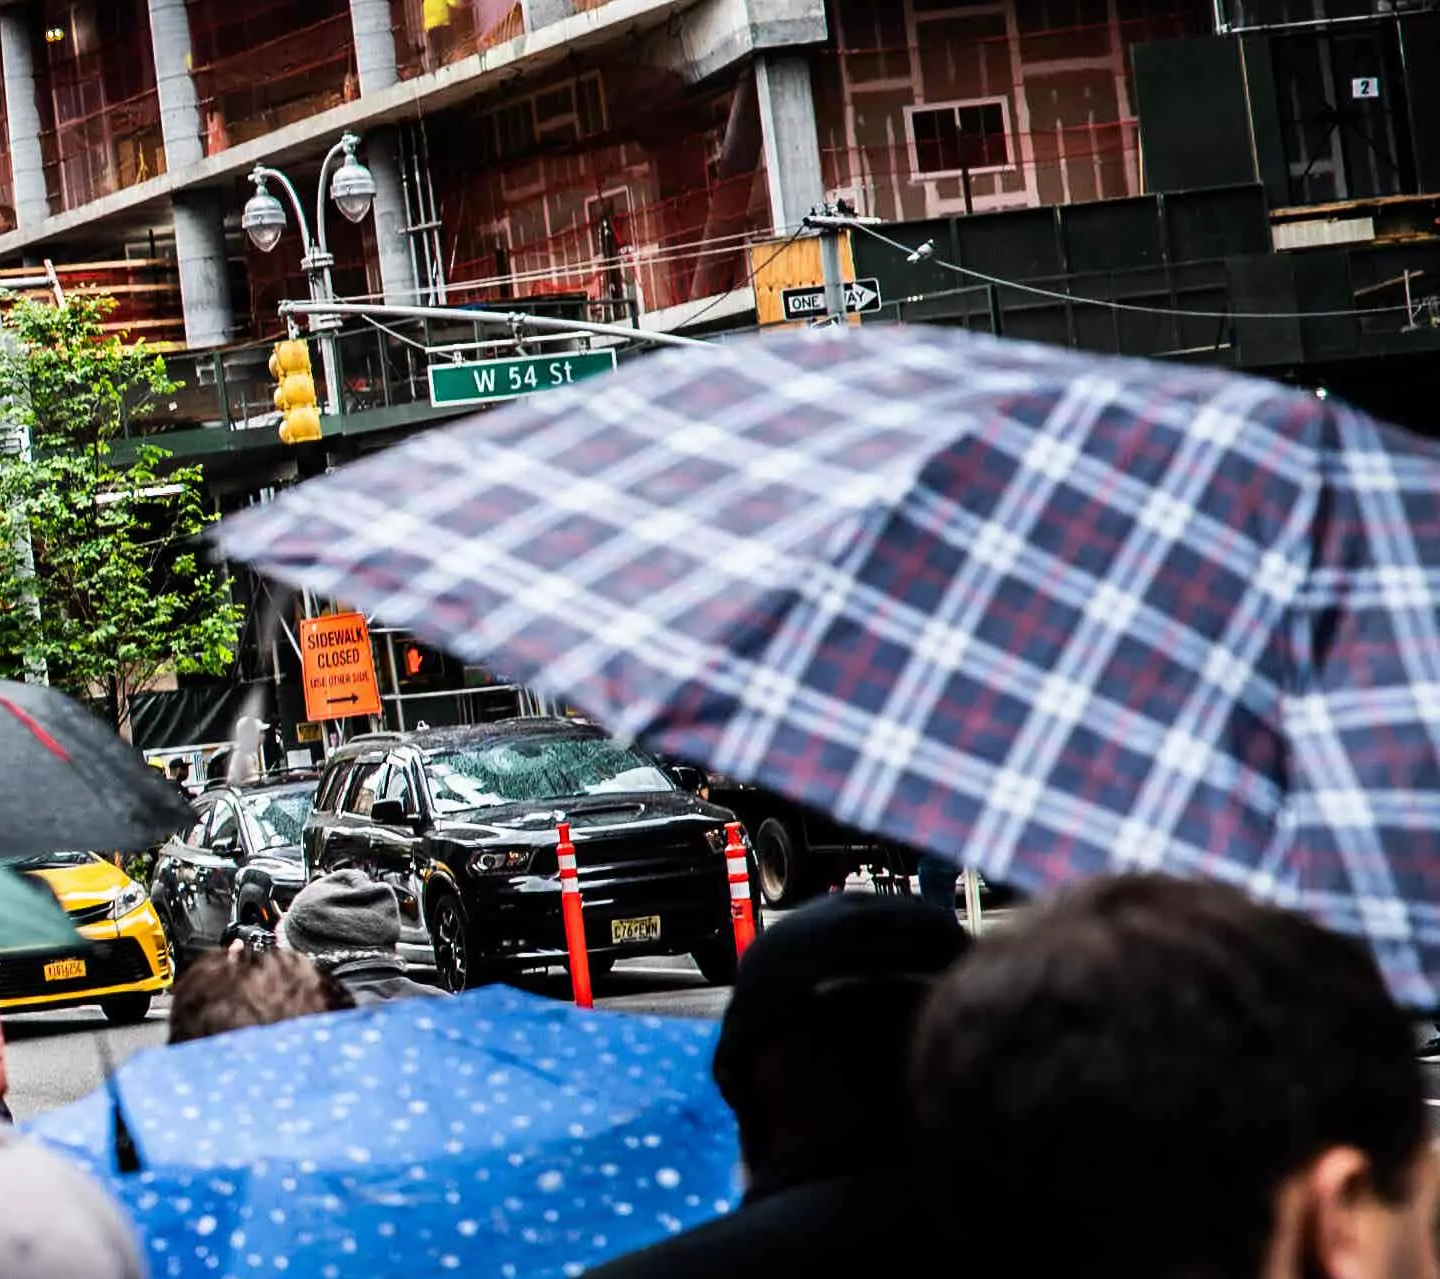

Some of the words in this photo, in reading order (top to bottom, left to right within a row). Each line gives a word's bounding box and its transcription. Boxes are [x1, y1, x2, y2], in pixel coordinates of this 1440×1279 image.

[1362, 81, 1371, 96] 2
[792, 295, 820, 310] ONE
[844, 289, 865, 306] AY
[473, 367, 495, 393] W
[508, 365, 538, 390] 54
[549, 360, 574, 385] St
[308, 628, 364, 650] SIDEWALK
[317, 647, 360, 669] CLOSED
